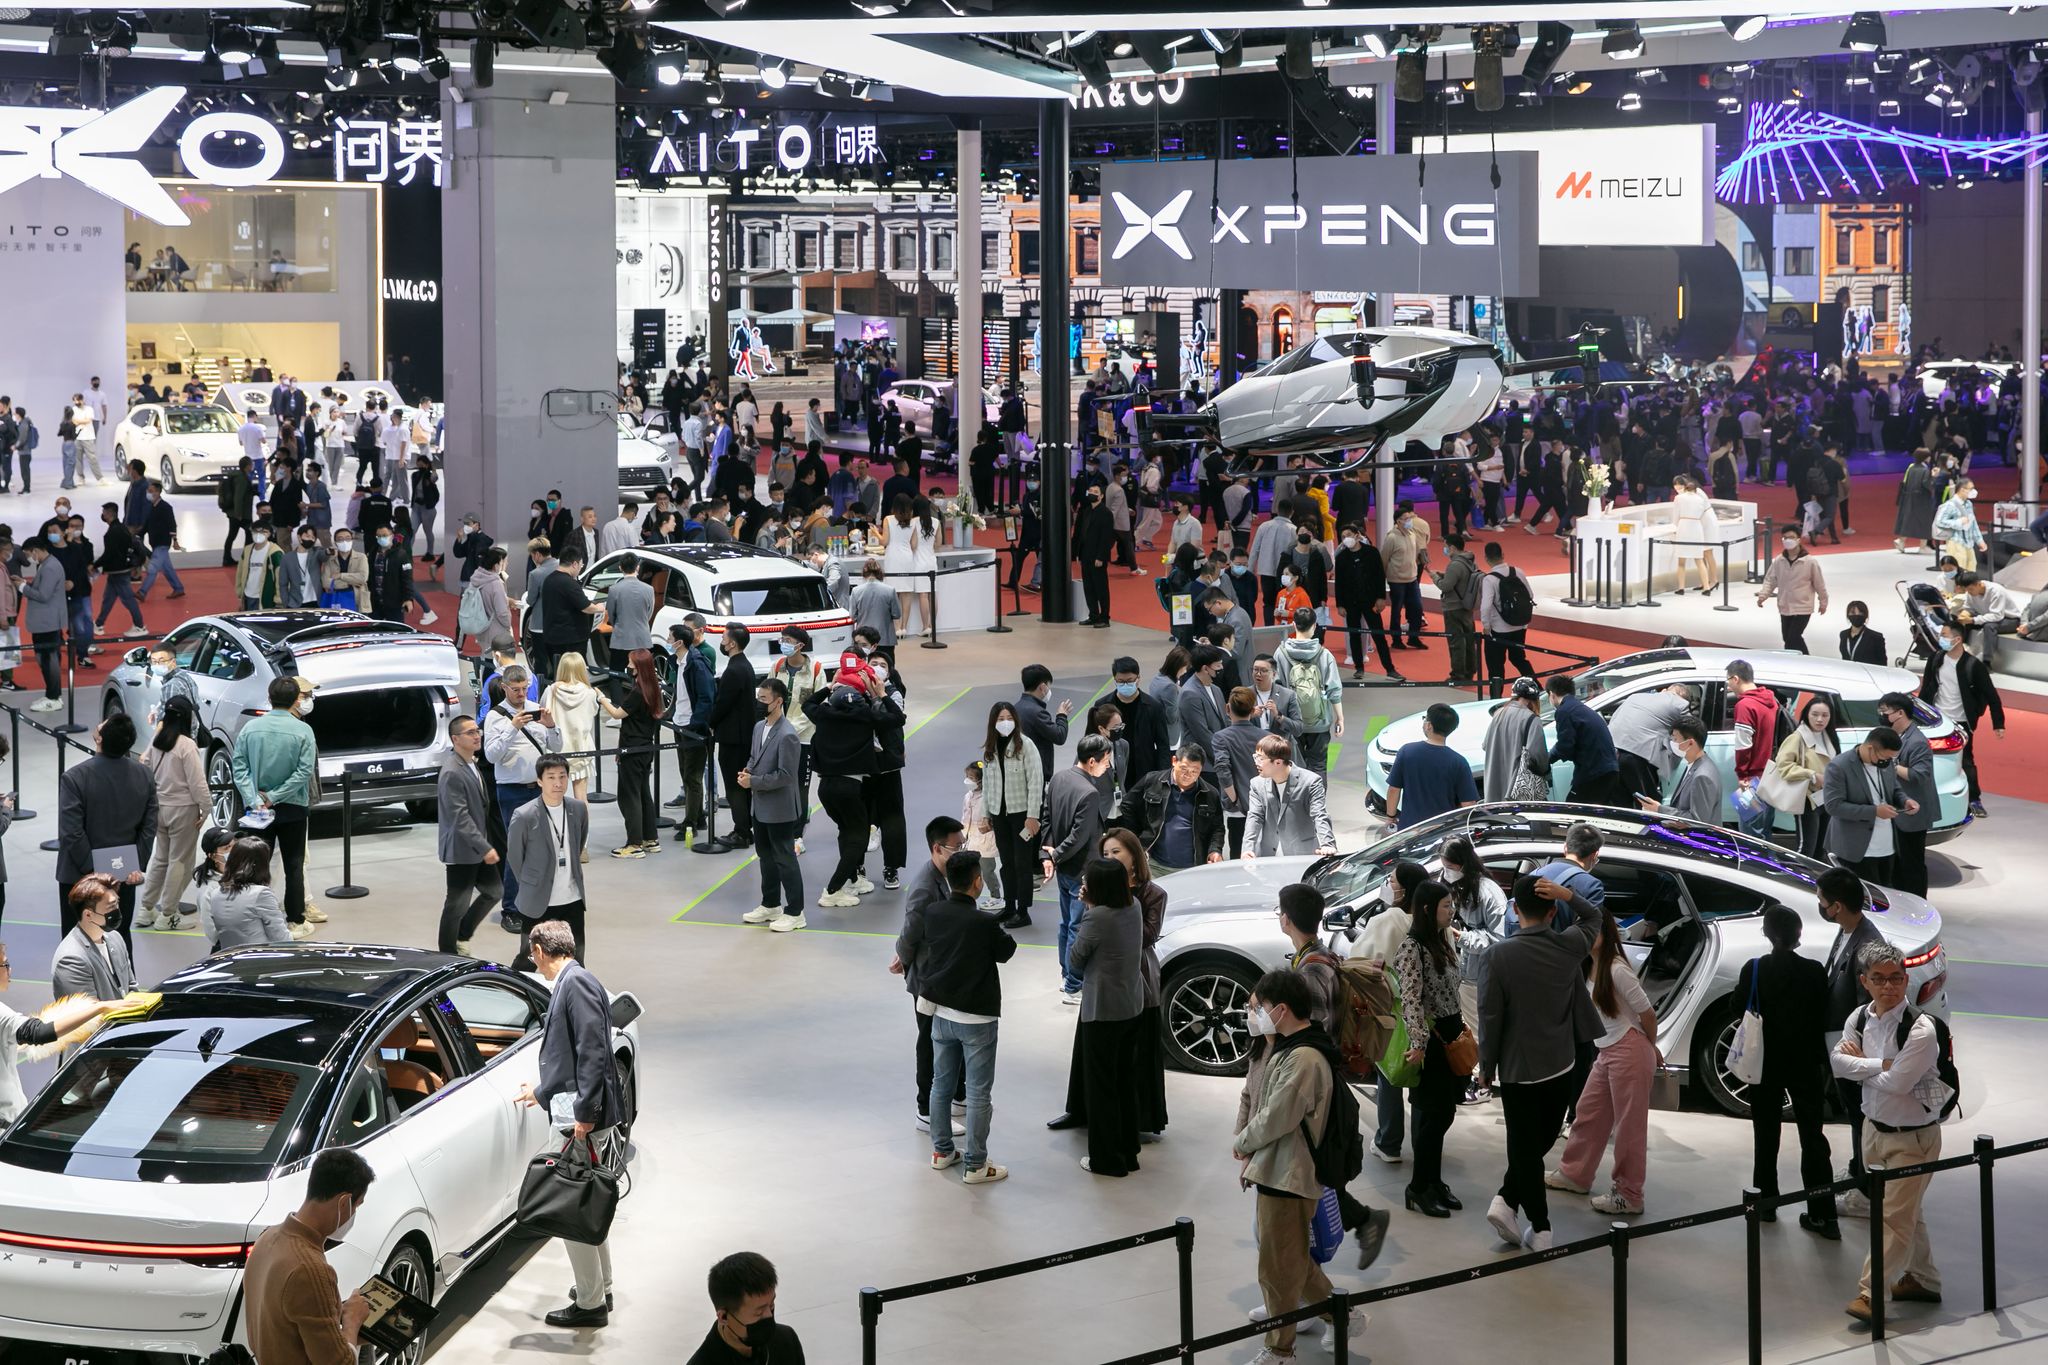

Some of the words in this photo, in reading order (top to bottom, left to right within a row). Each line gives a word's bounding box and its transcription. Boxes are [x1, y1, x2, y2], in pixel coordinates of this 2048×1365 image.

[650, 125, 812, 173] AITO
[836, 125, 879, 165] 问界
[1600, 176, 1682, 199] MEIZU
[1209, 203, 1495, 246] XPENG
[367, 764, 383, 774] G6
[3, 1252, 155, 1275] XPENG
[1045, 1254, 1073, 1265] XPENG
[1383, 1286, 1410, 1296] XPENG
[1255, 1319, 1283, 1331] XPENG
